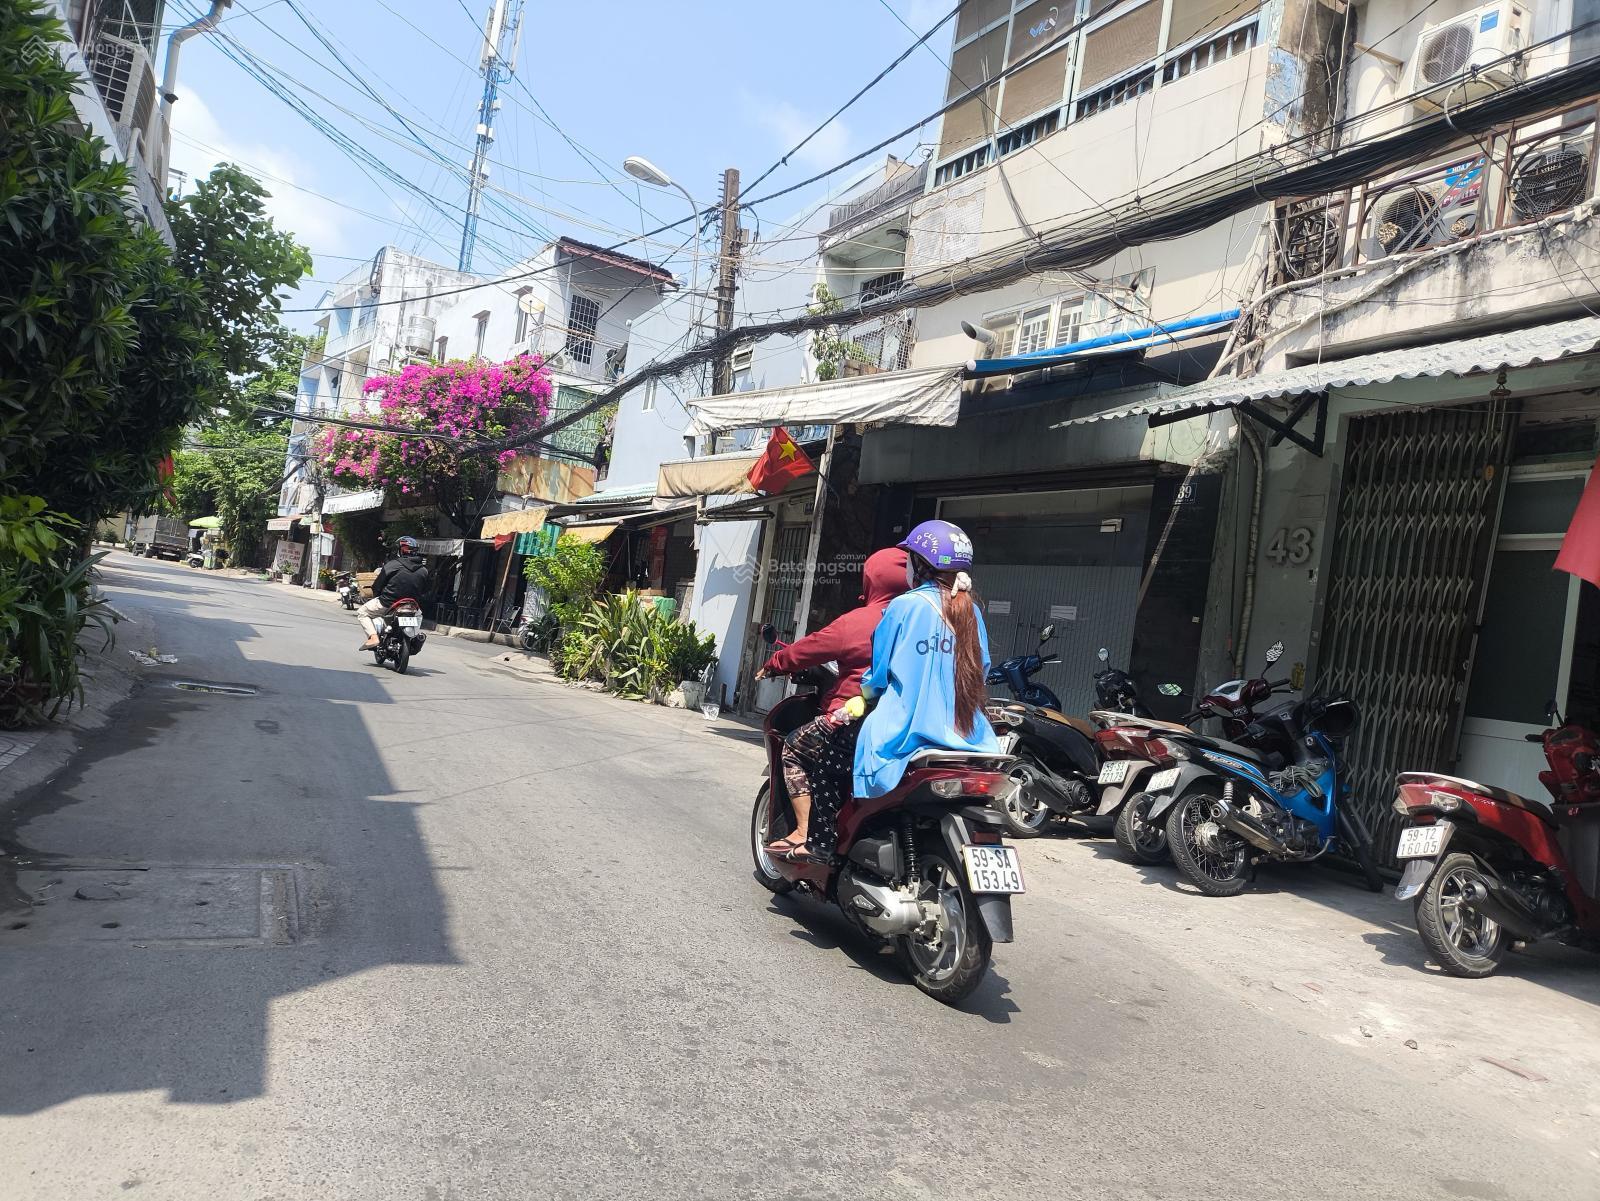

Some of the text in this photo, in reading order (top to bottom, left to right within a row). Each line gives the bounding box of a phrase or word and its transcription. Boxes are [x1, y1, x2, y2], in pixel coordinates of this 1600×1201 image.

[1266, 527, 1312, 564] 43
[1406, 828, 1437, 842] 59-T2
[971, 848, 1012, 869] 59-SA
[973, 869, 1020, 890] 153.49
